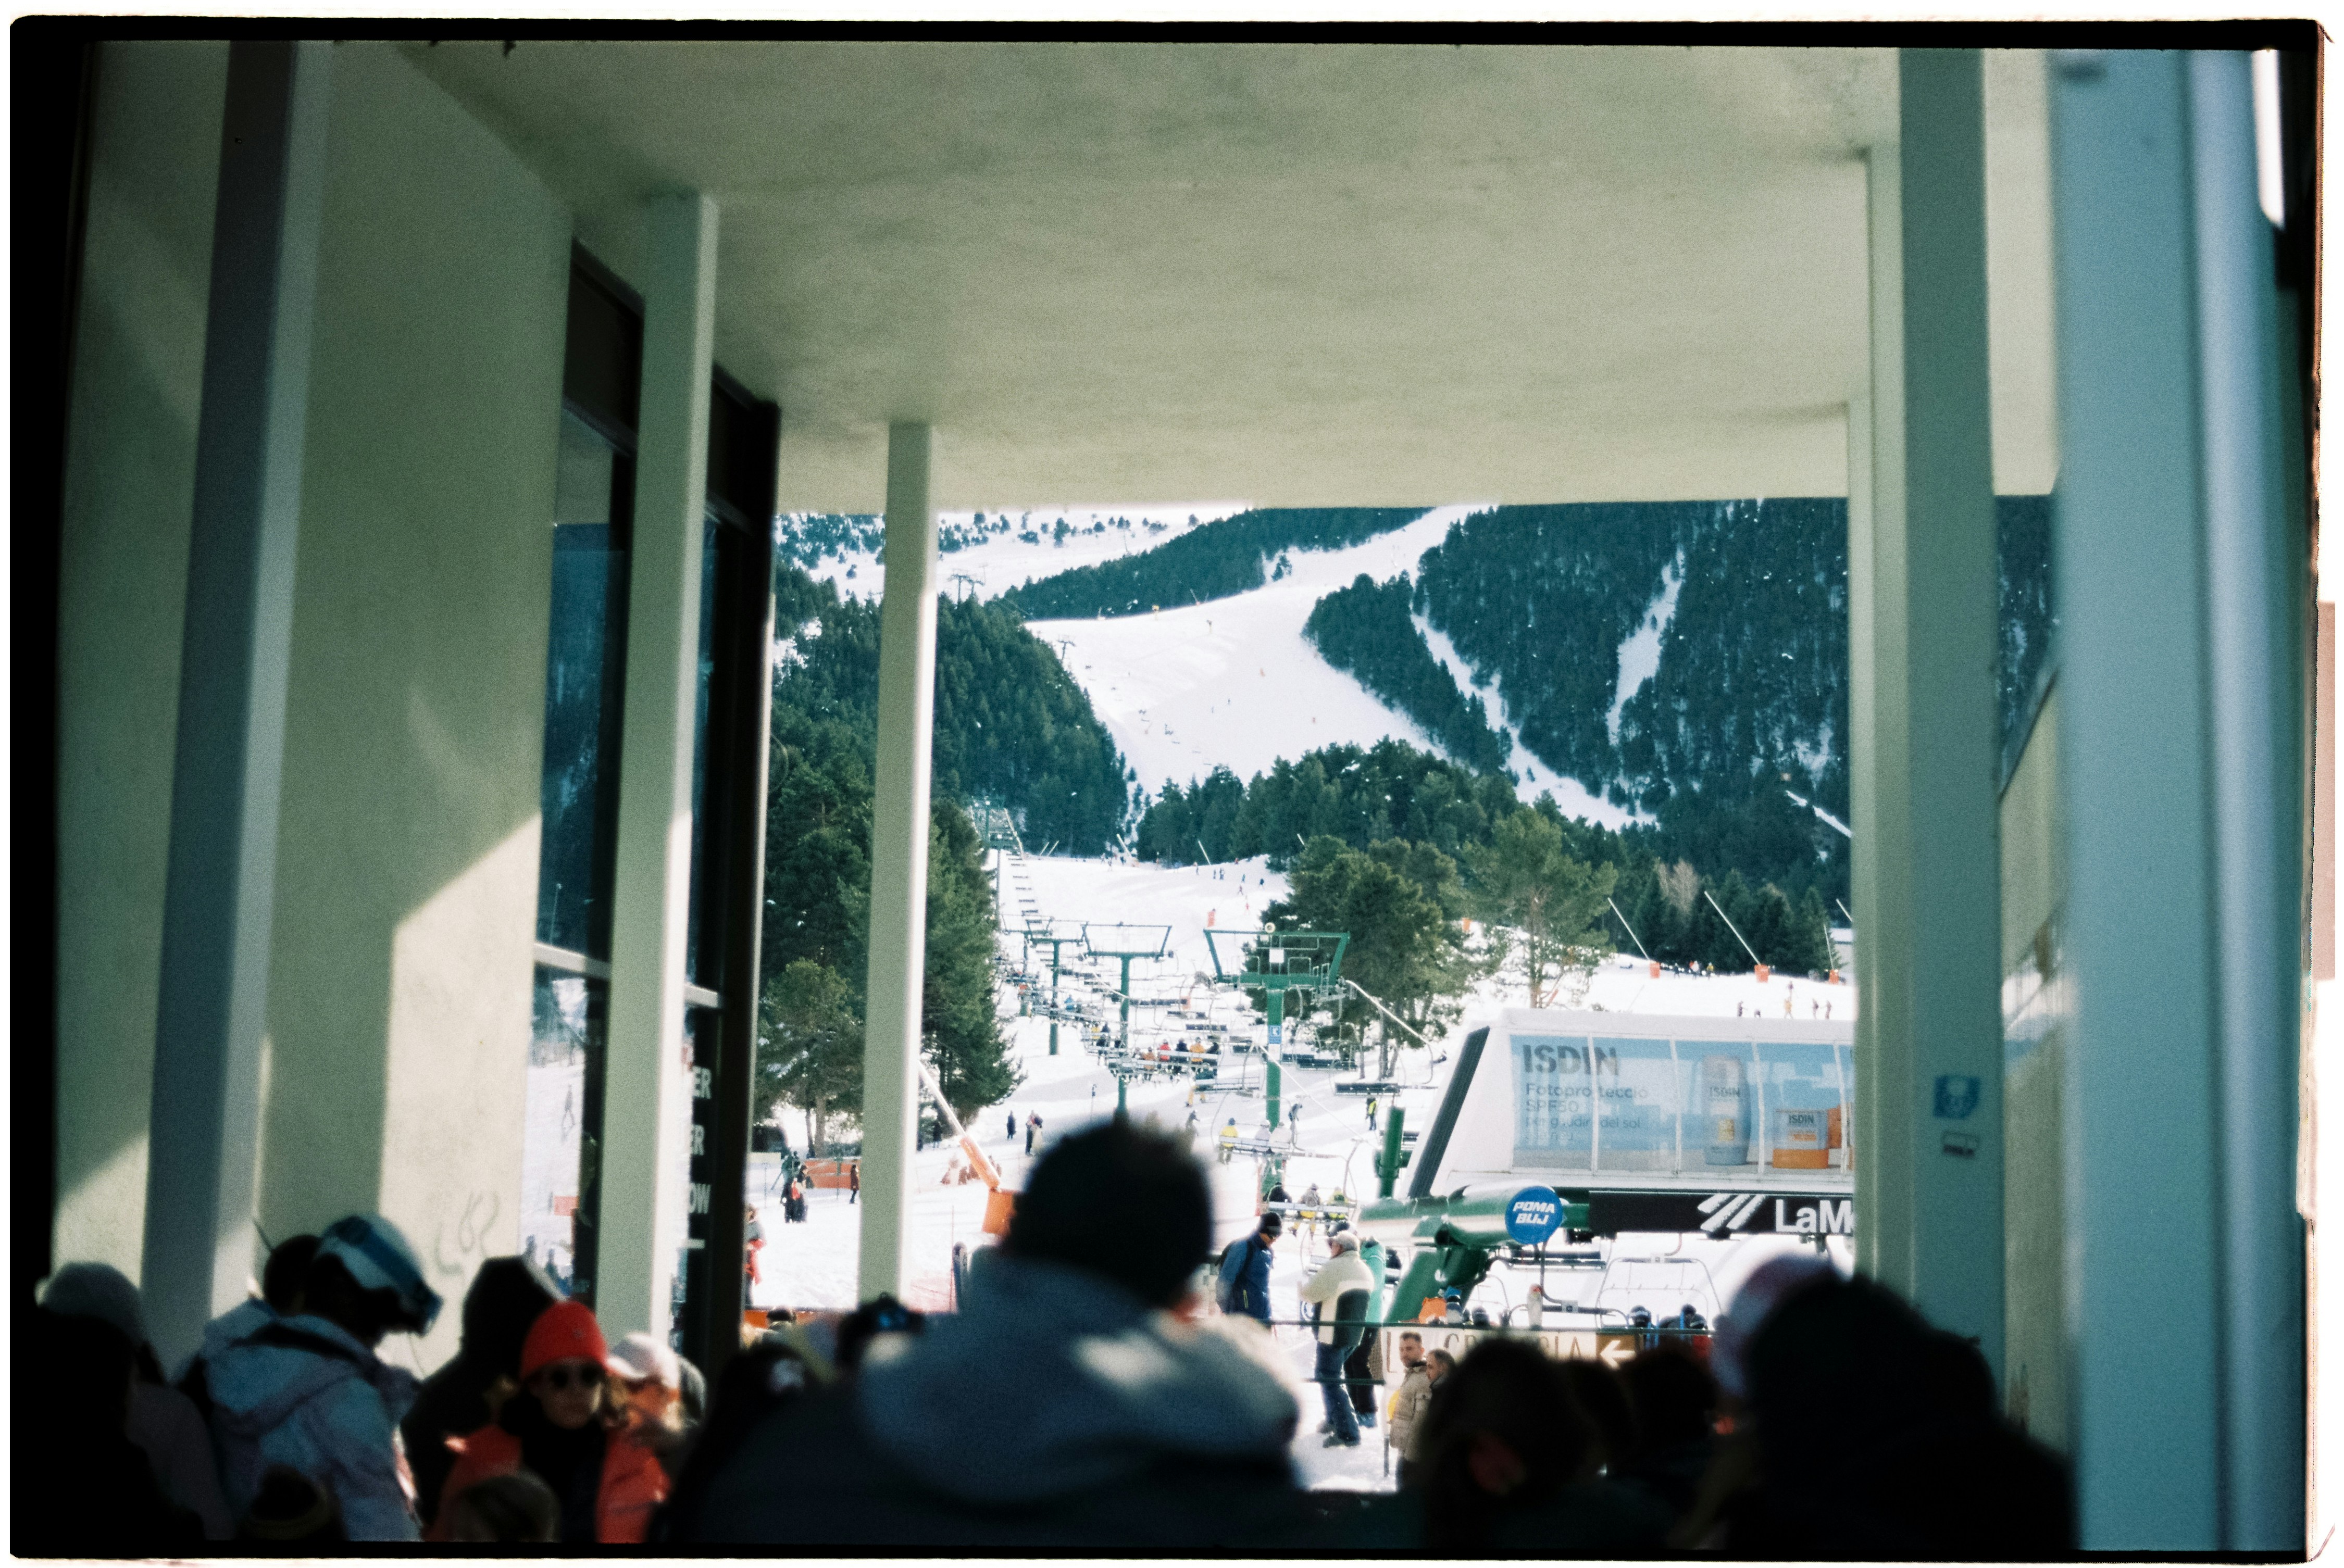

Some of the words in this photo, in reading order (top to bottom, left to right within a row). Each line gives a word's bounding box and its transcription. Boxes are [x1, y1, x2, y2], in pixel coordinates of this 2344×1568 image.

[1523, 1044, 1619, 1075] ISDIN
[1600, 1117, 1618, 1127] del
[1623, 1117, 1640, 1128] sol
[1788, 1114, 1814, 1124] ISDIN
[1513, 1201, 1555, 1213] POMA
[1776, 1199, 1855, 1233] LaM
